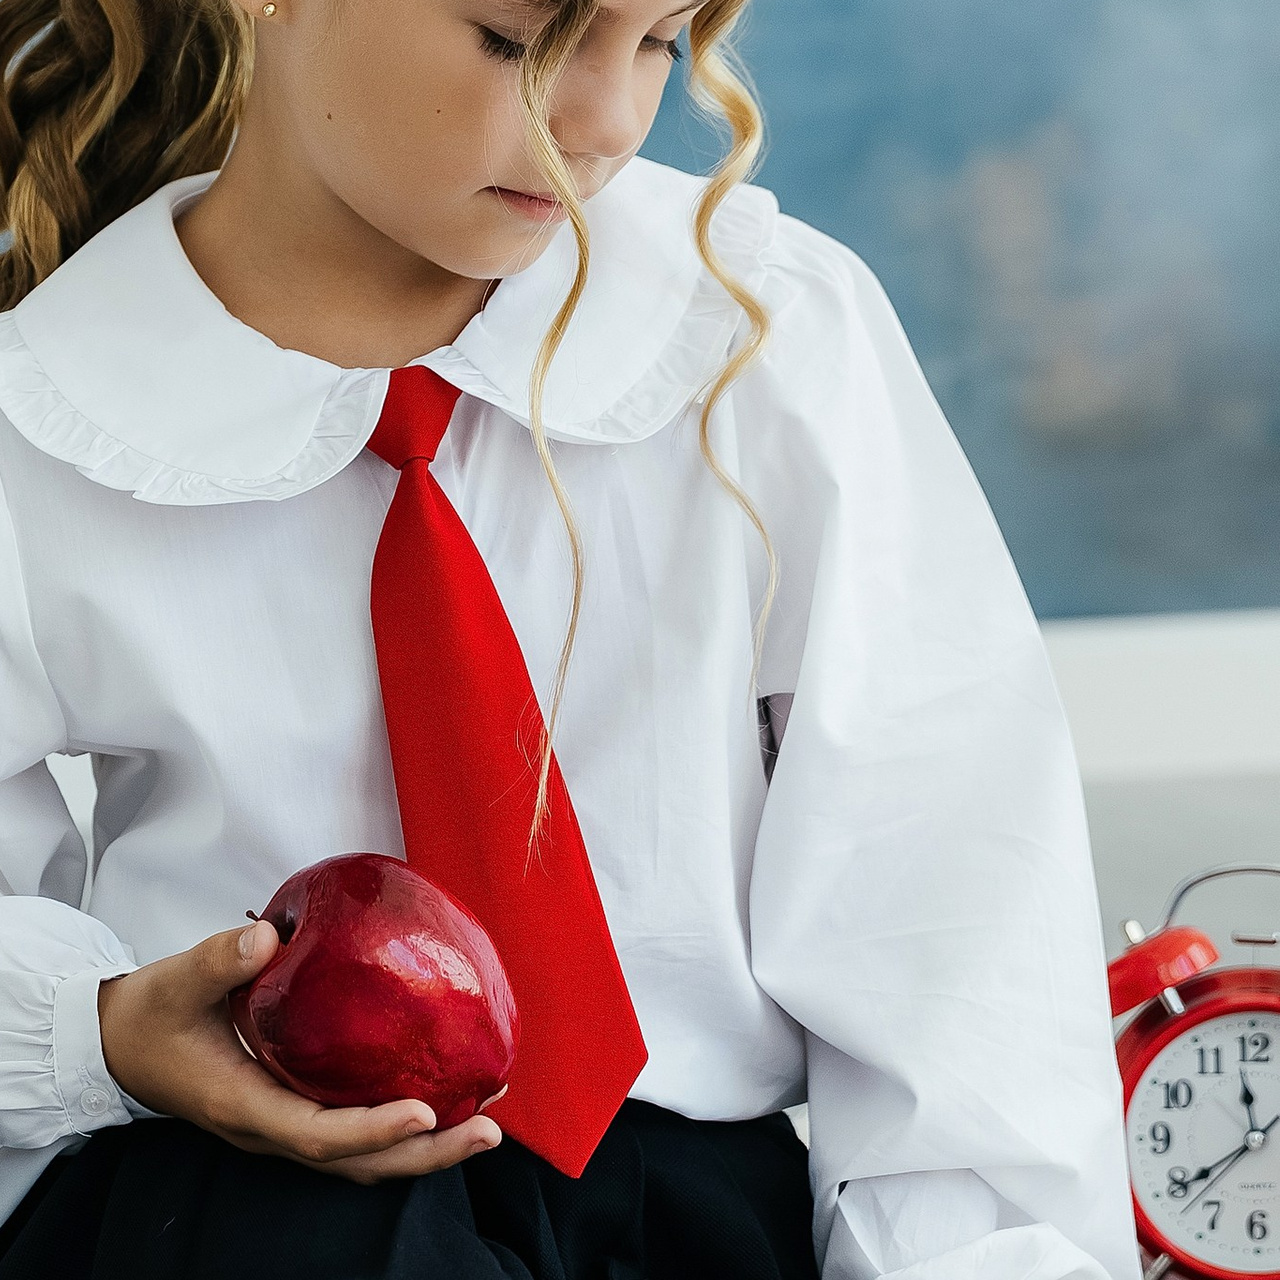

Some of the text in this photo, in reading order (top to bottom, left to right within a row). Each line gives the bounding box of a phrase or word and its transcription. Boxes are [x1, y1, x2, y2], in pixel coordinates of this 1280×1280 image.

[1196, 1046, 1223, 1074] 11
[1237, 1032, 1271, 1062] 12
[1160, 1079, 1192, 1109] 10
[1150, 1121, 1171, 1154] 9
[1168, 1166, 1189, 1198] 8
[1202, 1200, 1221, 1231] 7
[1248, 1210, 1268, 1240] 6
